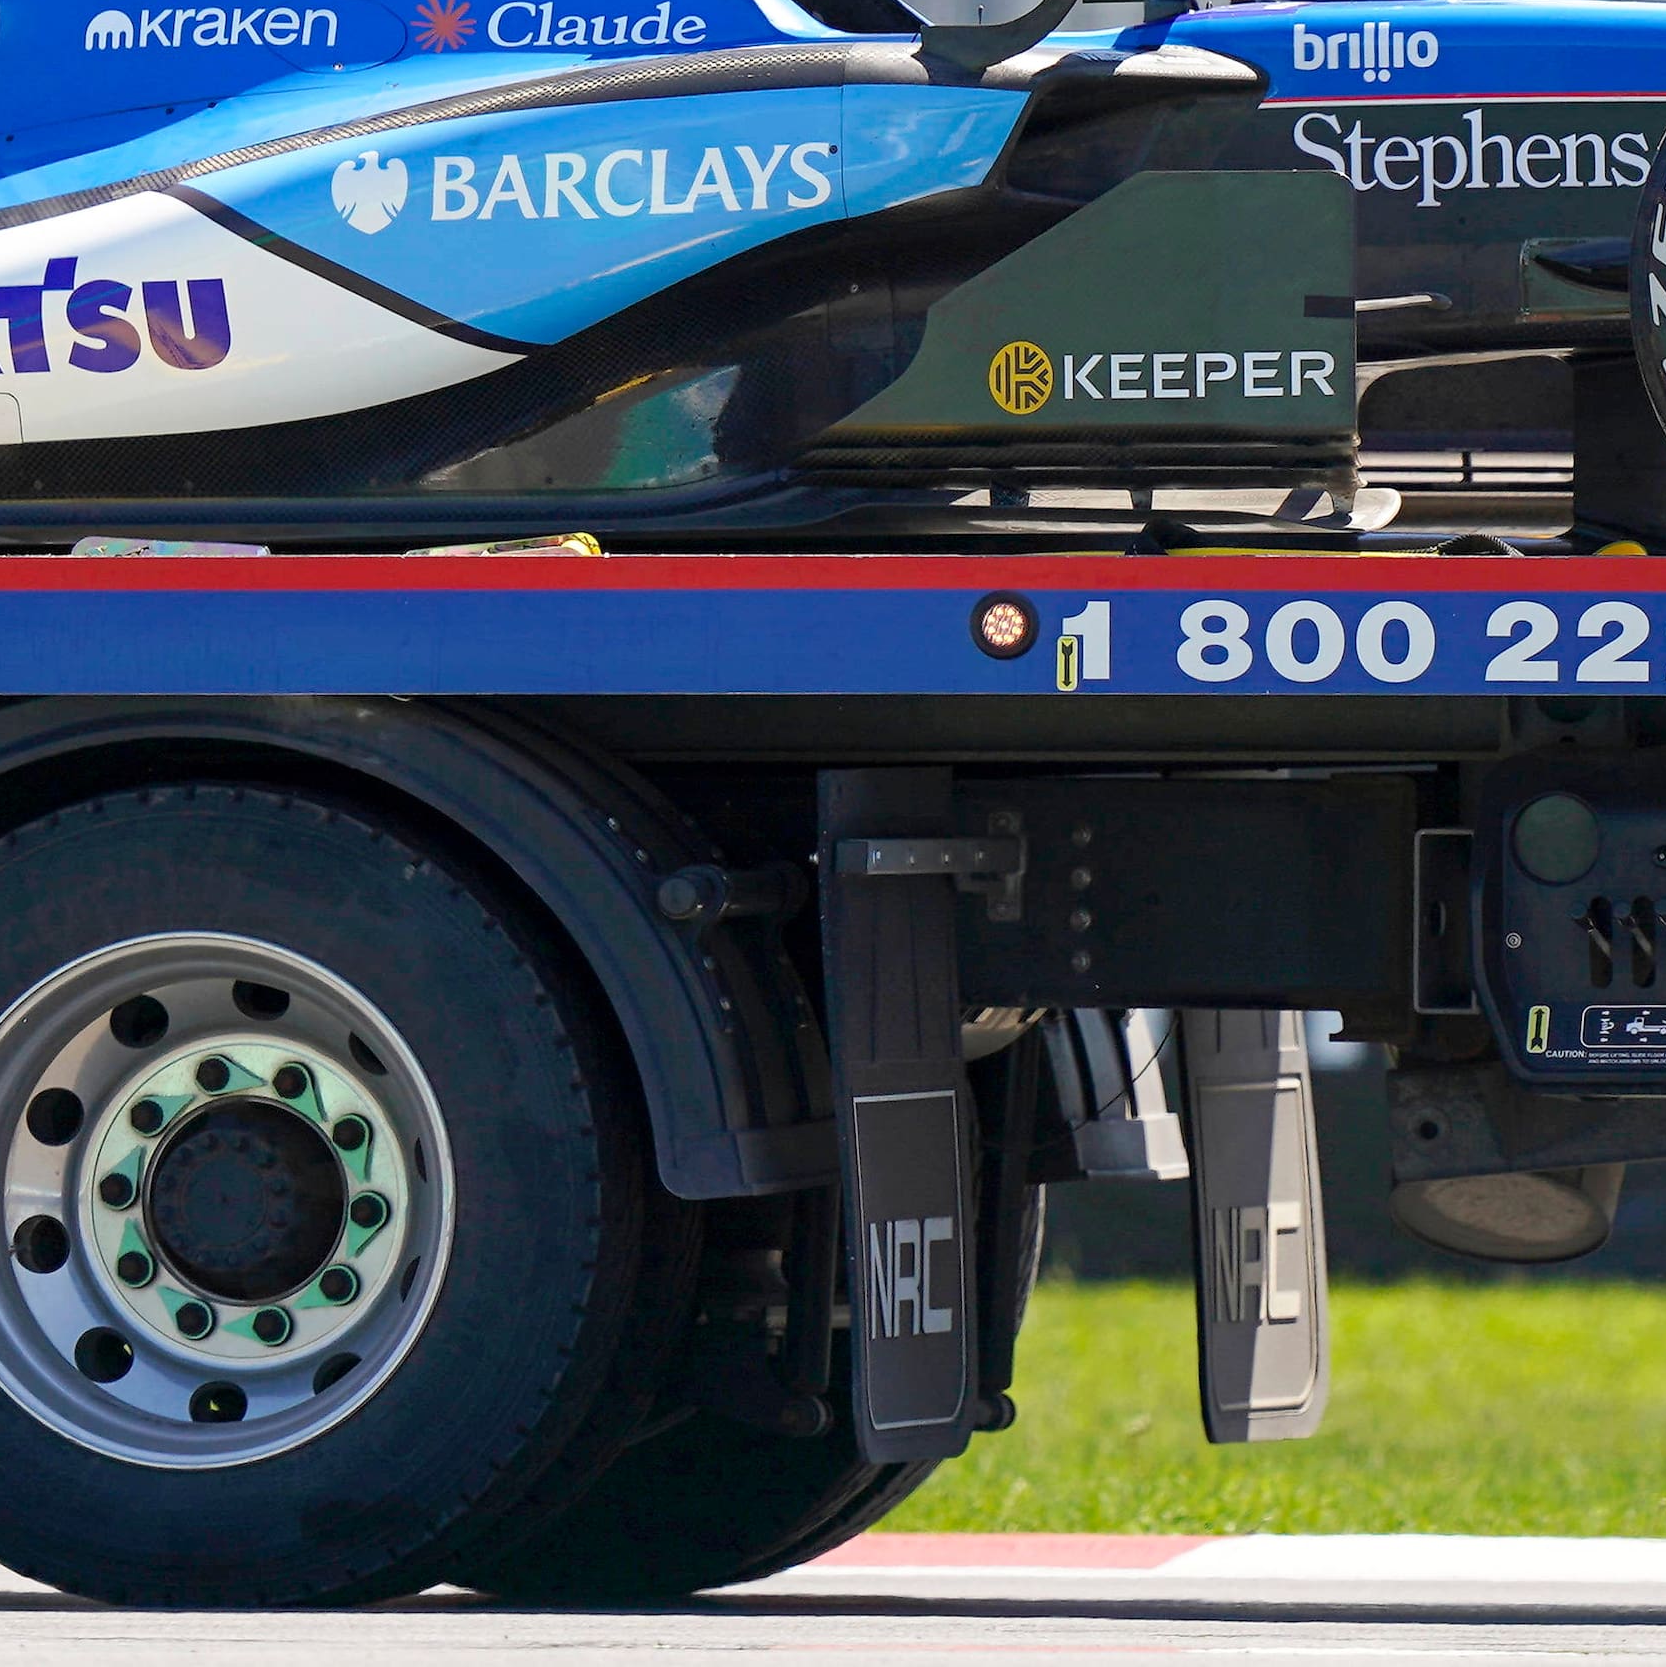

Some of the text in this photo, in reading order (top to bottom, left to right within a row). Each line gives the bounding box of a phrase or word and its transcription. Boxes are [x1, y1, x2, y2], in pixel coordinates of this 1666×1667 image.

[487, 1, 708, 48] Claude
[1293, 22, 1438, 83] brillio
[430, 142, 833, 222] BARCLAYS
[1293, 108, 1652, 208] Stephens
[1063, 351, 1335, 400] KEEPER
[1063, 601, 1110, 680] 1
[1176, 599, 1436, 685] 800
[1545, 1050, 1587, 1058] CAUTION:
[869, 1216, 953, 1340] NRC
[1213, 1200, 1301, 1323] NRC
